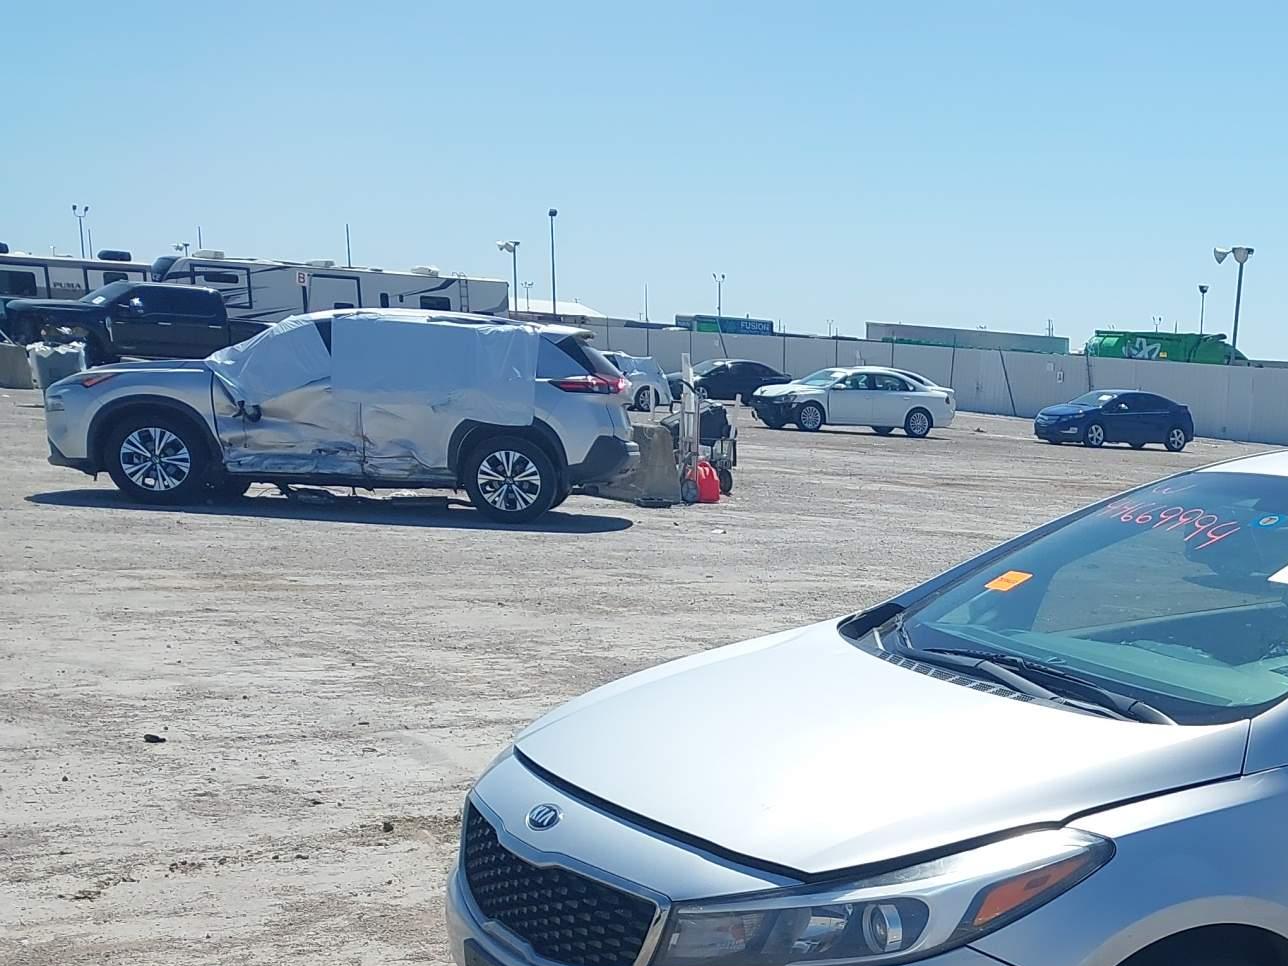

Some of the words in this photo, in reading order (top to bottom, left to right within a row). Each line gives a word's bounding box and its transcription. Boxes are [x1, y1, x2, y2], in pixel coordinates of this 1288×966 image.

[298, 272, 306, 284] B
[53, 281, 82, 290] PUMA
[740, 321, 770, 331] FUSION
[530, 805, 556, 826] KIA
